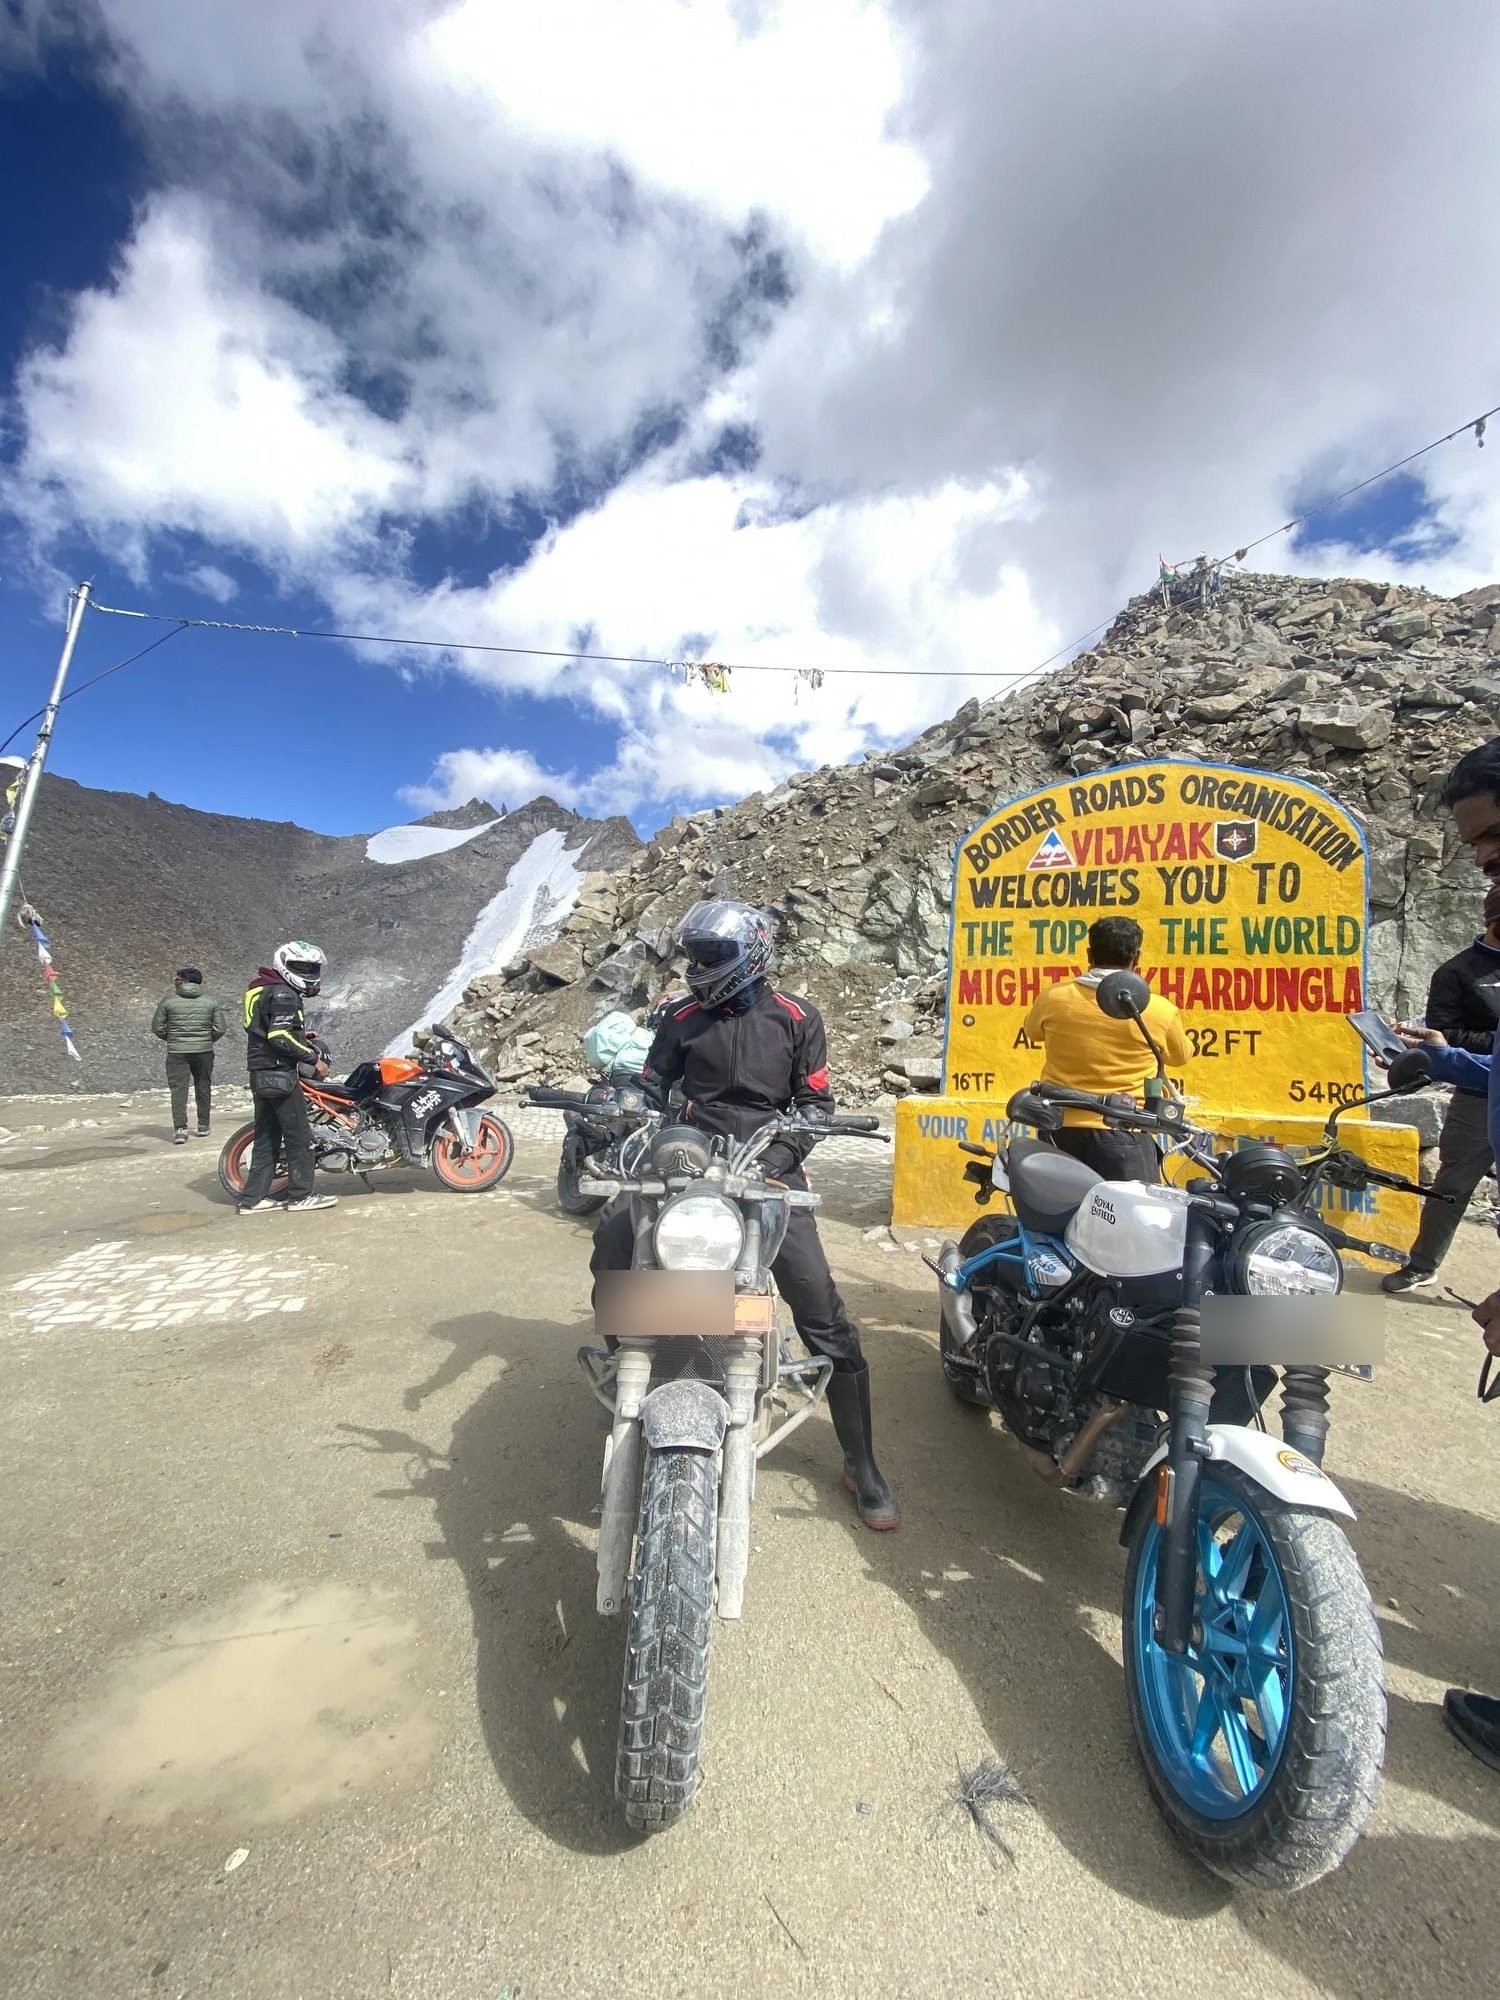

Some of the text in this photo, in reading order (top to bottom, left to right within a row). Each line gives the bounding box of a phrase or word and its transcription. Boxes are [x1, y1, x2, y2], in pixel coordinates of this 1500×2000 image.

[964, 773, 1364, 875] BORDER ROADS ORGANISATION
[1071, 820, 1215, 866] VIJAYAK
[968, 861, 1300, 908] WELCOMES YOU TO
[961, 915, 1361, 956] THE TOP THE WORLD
[958, 966, 1083, 1007] MIGHT
[917, 1114, 969, 1141] YOUR
[1091, 1205, 1116, 1225] ENFIELD
[1093, 1195, 1115, 1213] ROYAL
